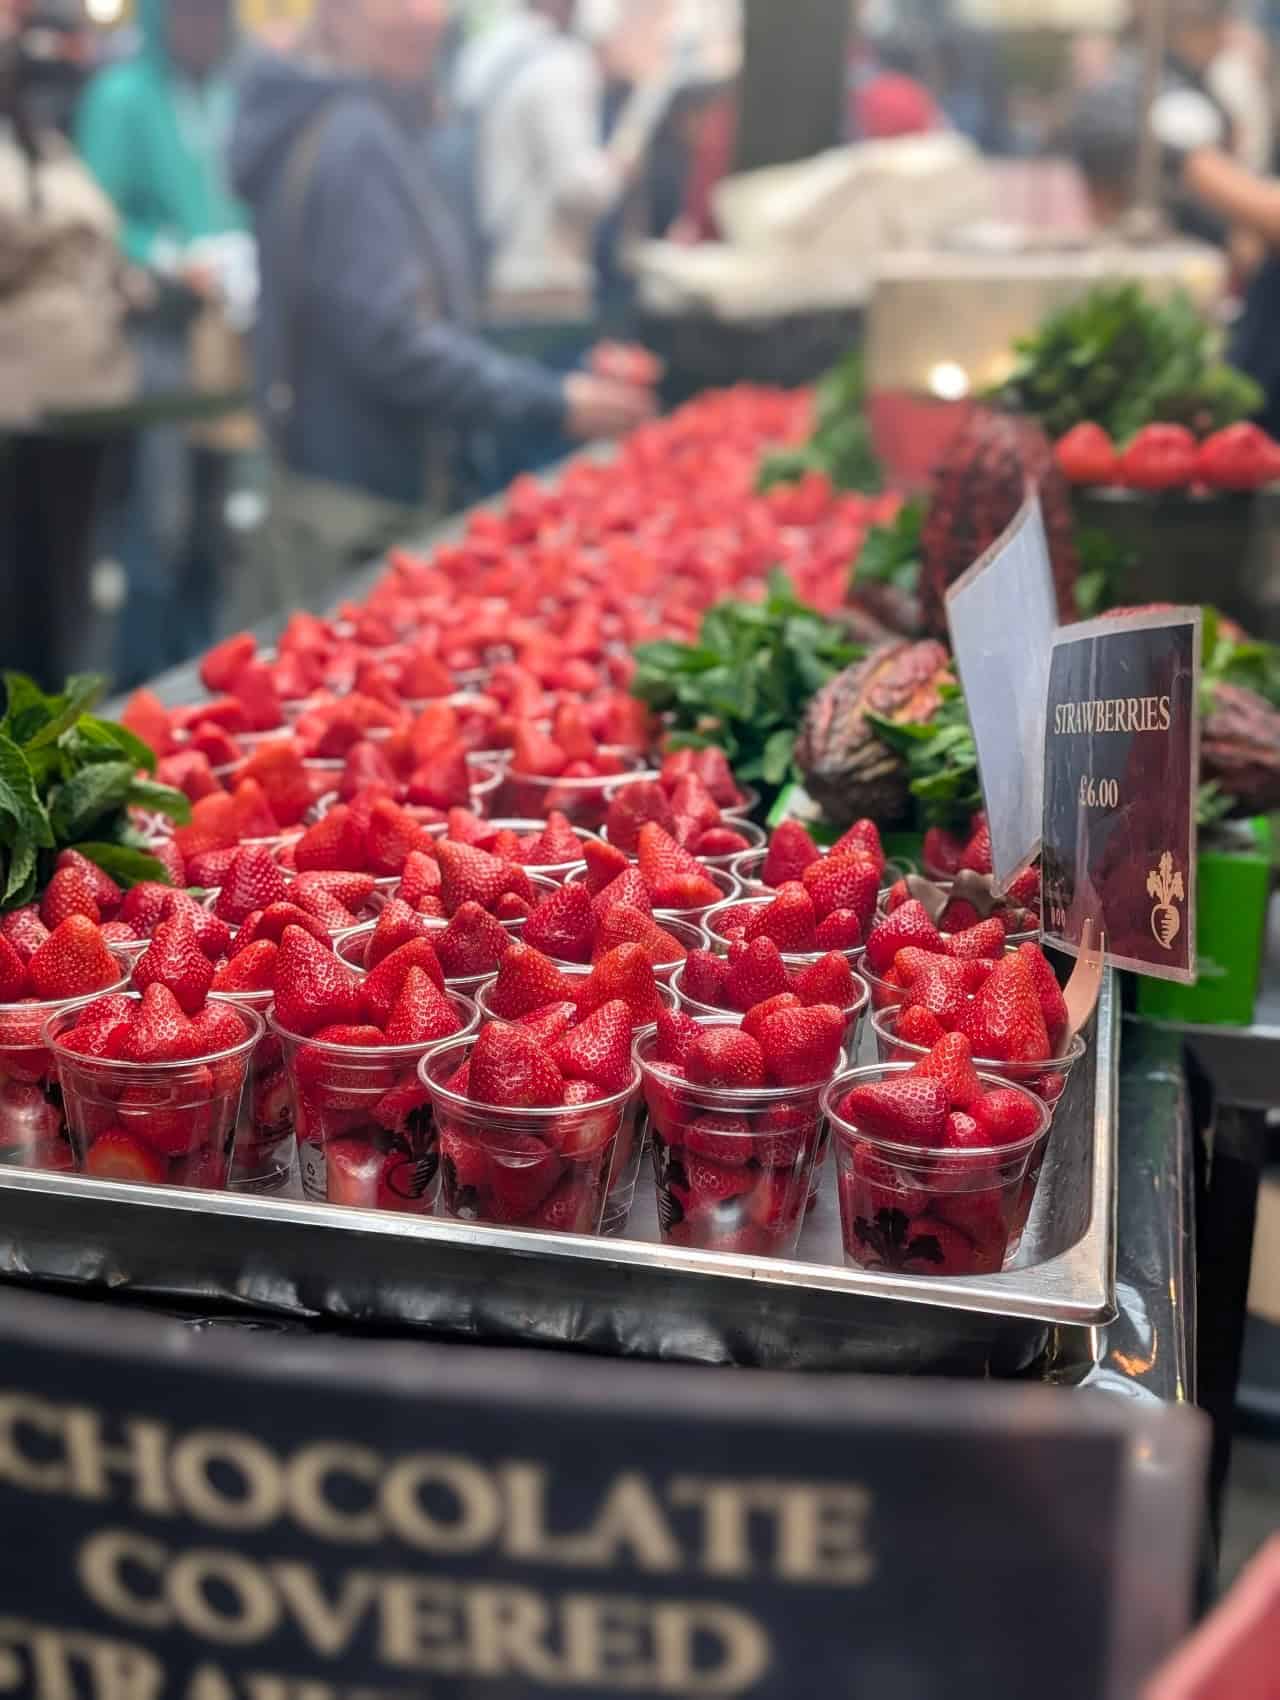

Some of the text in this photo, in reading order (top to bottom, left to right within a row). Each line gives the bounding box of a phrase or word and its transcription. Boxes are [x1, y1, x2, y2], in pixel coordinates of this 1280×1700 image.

[1054, 696, 1170, 735] STRAWBERRIES
[1079, 775, 1118, 808] £6.00
[0, 1395, 871, 1583] CHOCOLATE
[78, 1530, 769, 1695] COVERED
